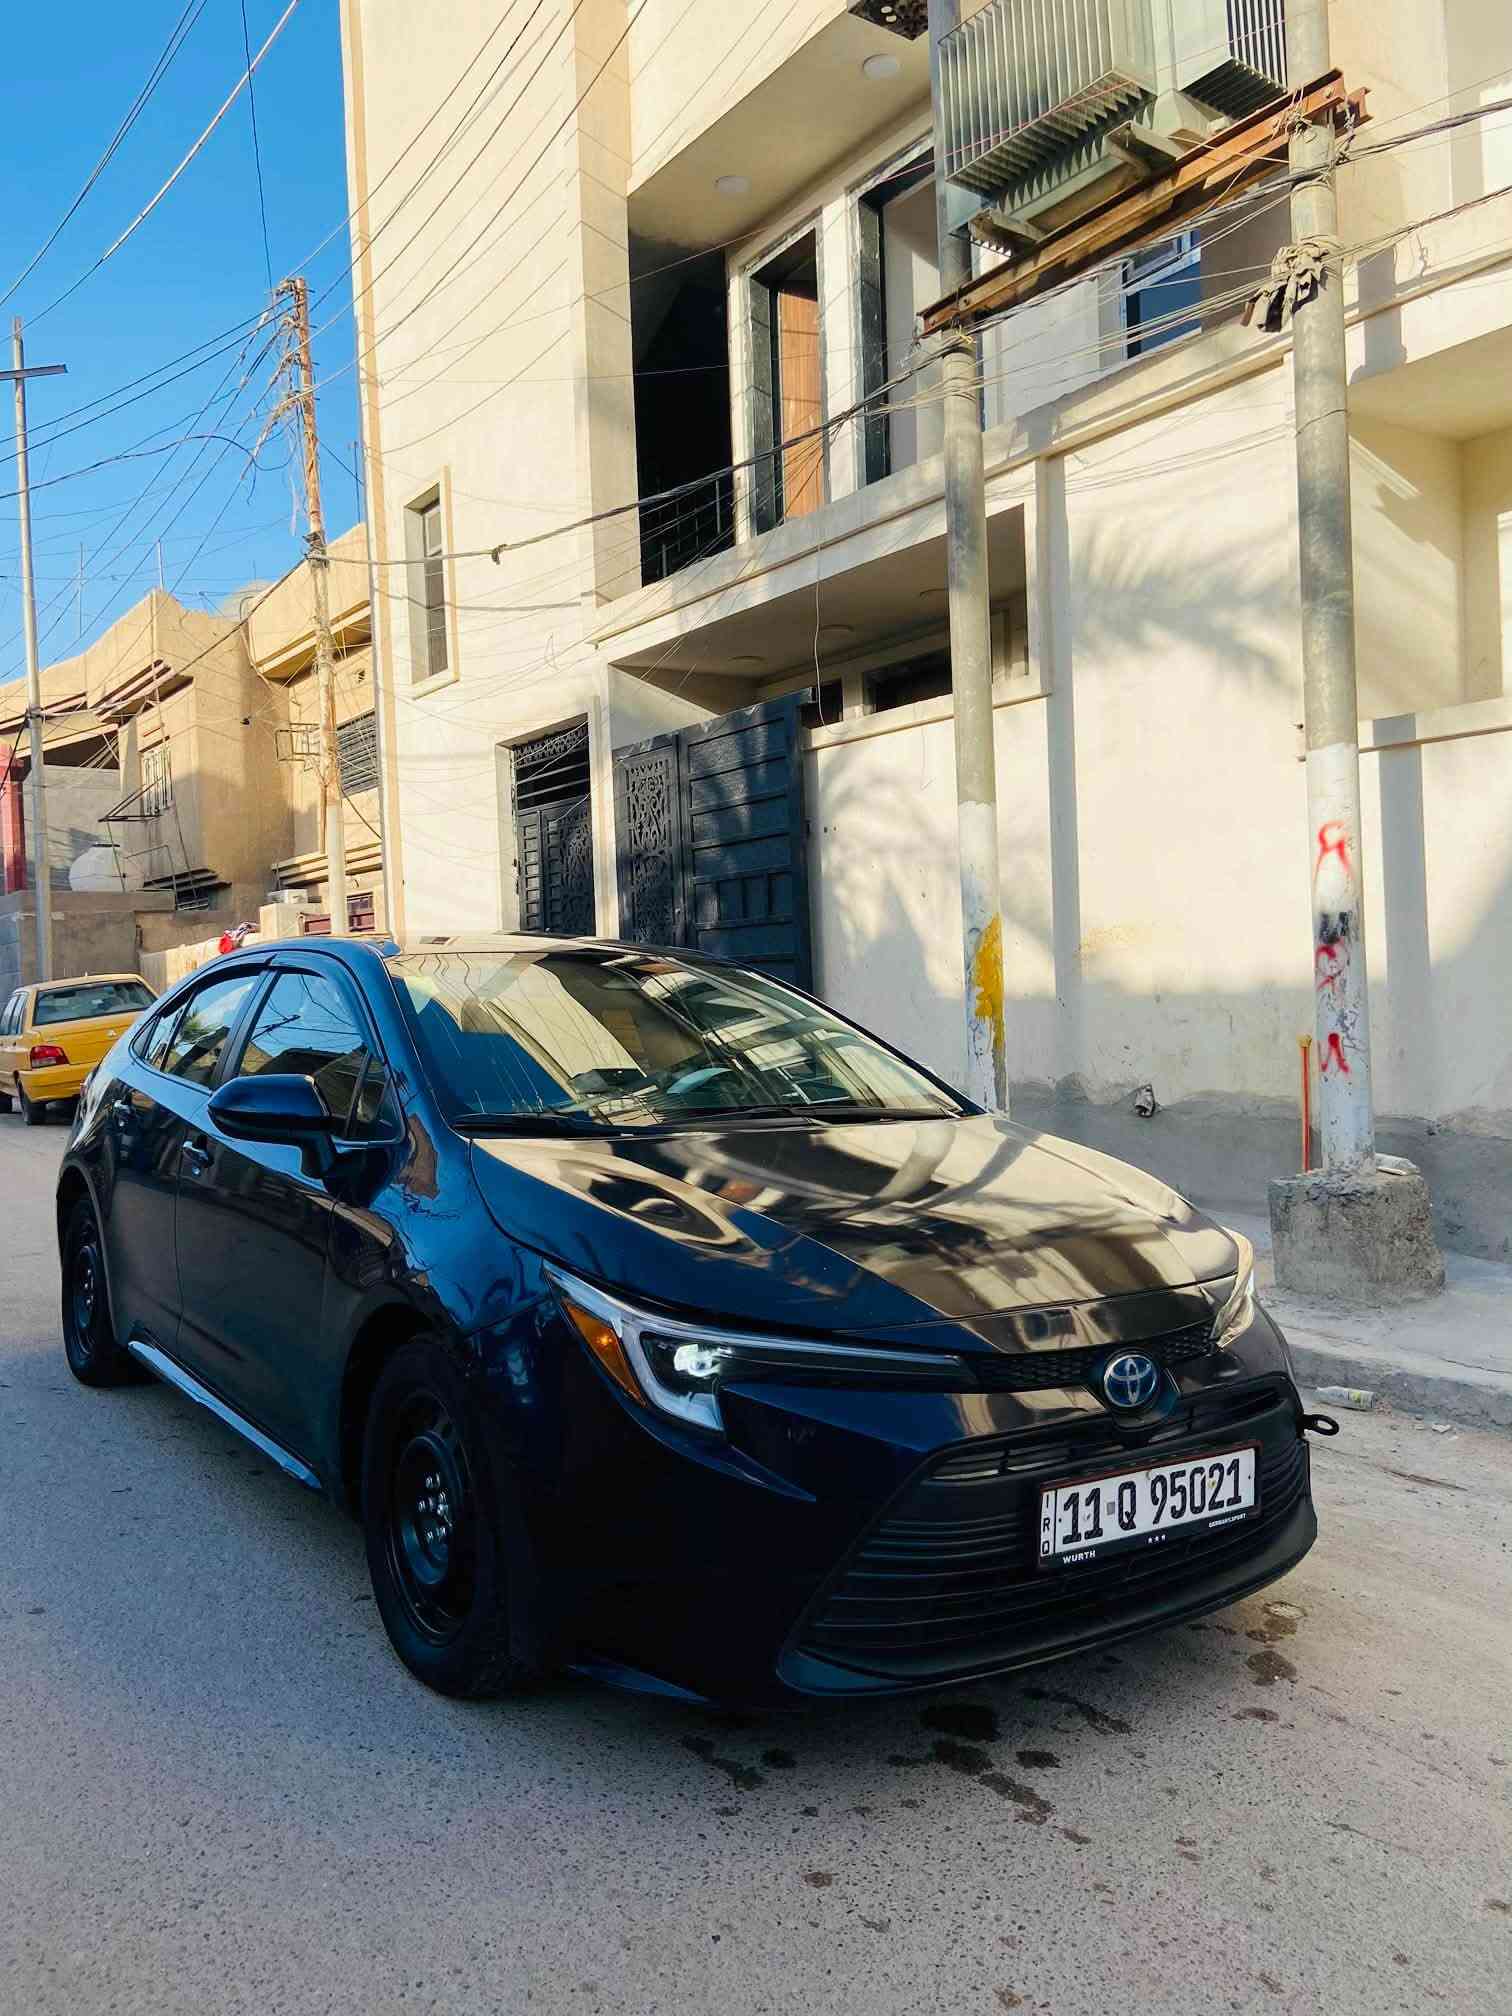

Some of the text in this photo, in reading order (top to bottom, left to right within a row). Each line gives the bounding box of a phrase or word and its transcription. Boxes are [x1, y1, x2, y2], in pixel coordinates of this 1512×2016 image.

[1063, 1458, 1242, 1545] 11 Q 95021
[1062, 1550, 1096, 1564] WURTH
